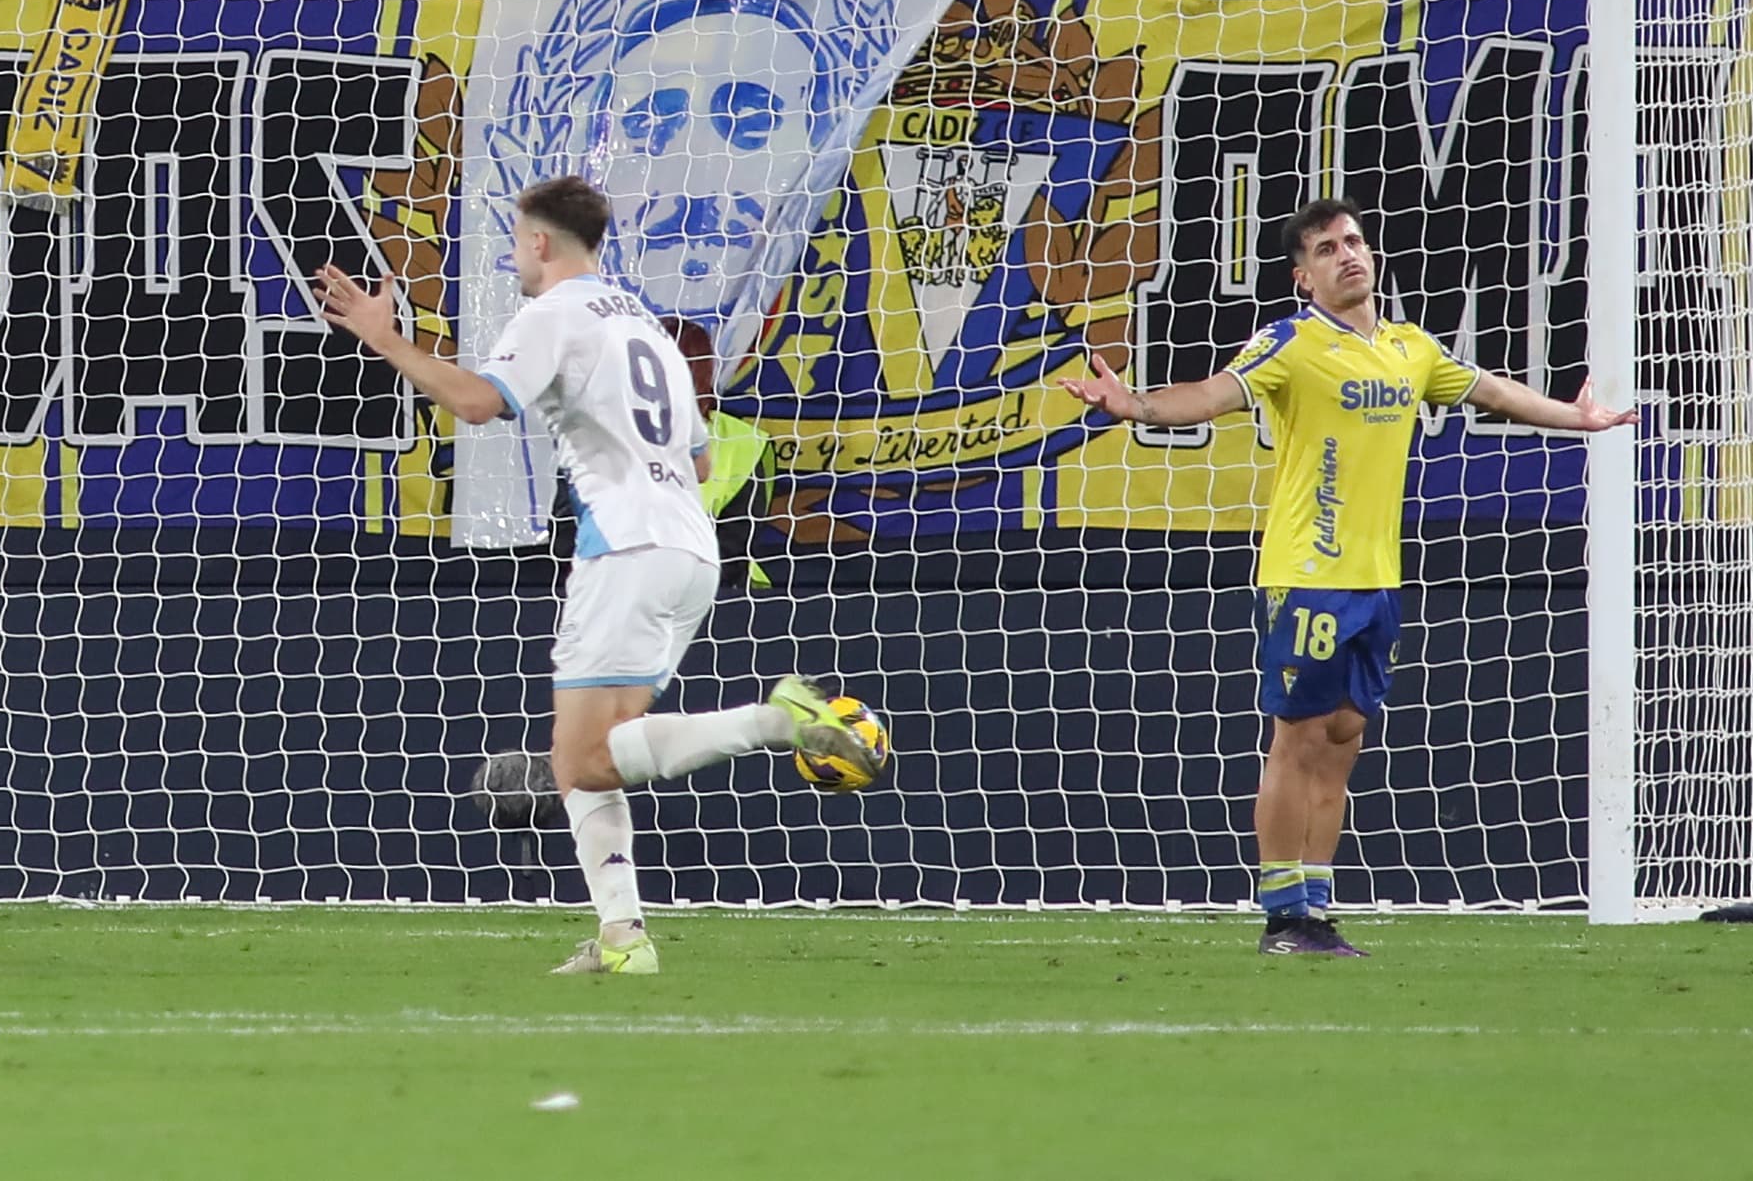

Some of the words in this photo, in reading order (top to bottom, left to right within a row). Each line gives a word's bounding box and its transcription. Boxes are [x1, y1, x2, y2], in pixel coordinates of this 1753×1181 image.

[627, 338, 673, 446] 9
[854, 391, 1031, 467] Libertad
[1293, 607, 1338, 661] 18
